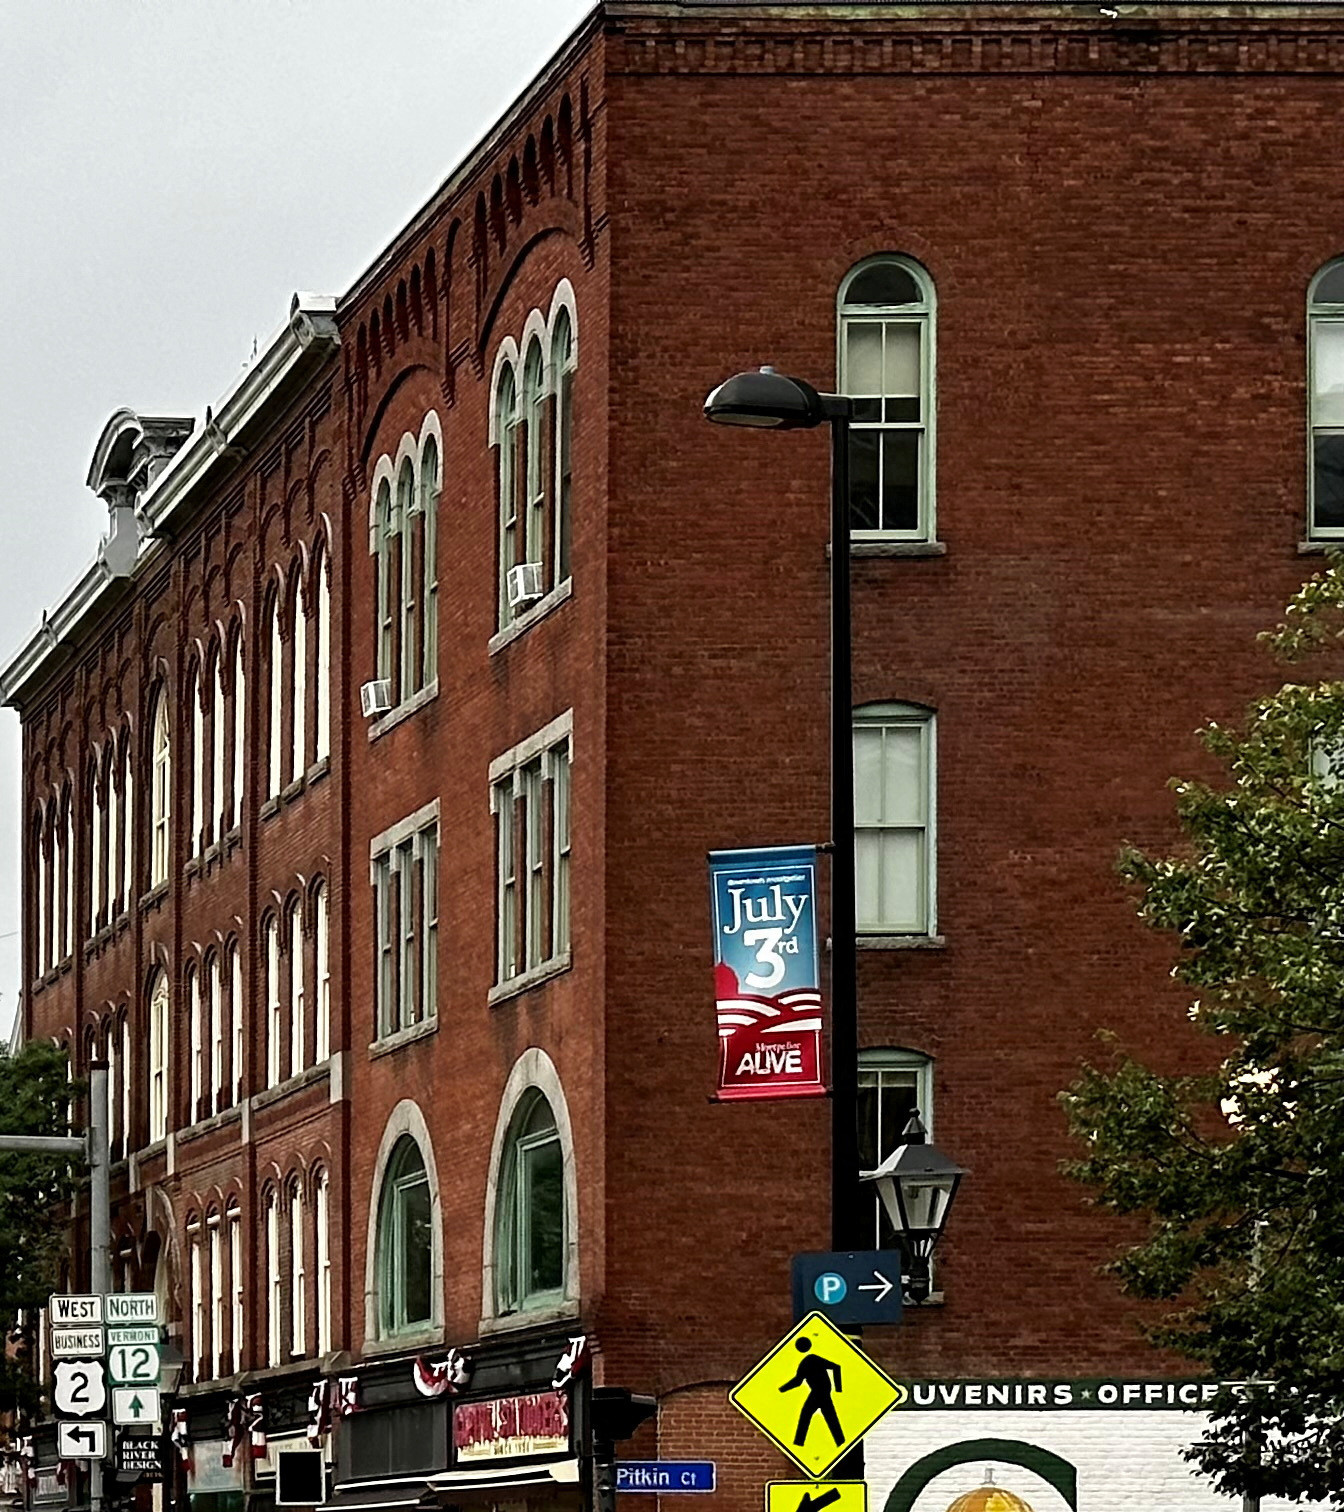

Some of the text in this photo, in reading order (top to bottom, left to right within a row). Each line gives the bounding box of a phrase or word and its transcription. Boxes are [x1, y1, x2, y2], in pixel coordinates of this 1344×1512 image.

[723, 884, 810, 935] July
[743, 926, 800, 990] 3rd
[735, 1050, 803, 1076] ALIVE
[823, 1275, 841, 1302] P
[57, 1299, 95, 1318] WEST
[109, 1297, 155, 1317] NORTH
[54, 1333, 101, 1350] BUSINESS
[109, 1329, 156, 1343] VERMONT
[117, 1347, 151, 1379] 12
[70, 1371, 90, 1403] 2
[122, 1440, 160, 1450] BLACK
[122, 1450, 156, 1460] RIVER
[122, 1460, 162, 1470] DESIGN
[616, 1467, 697, 1487] Pitkin Ct
